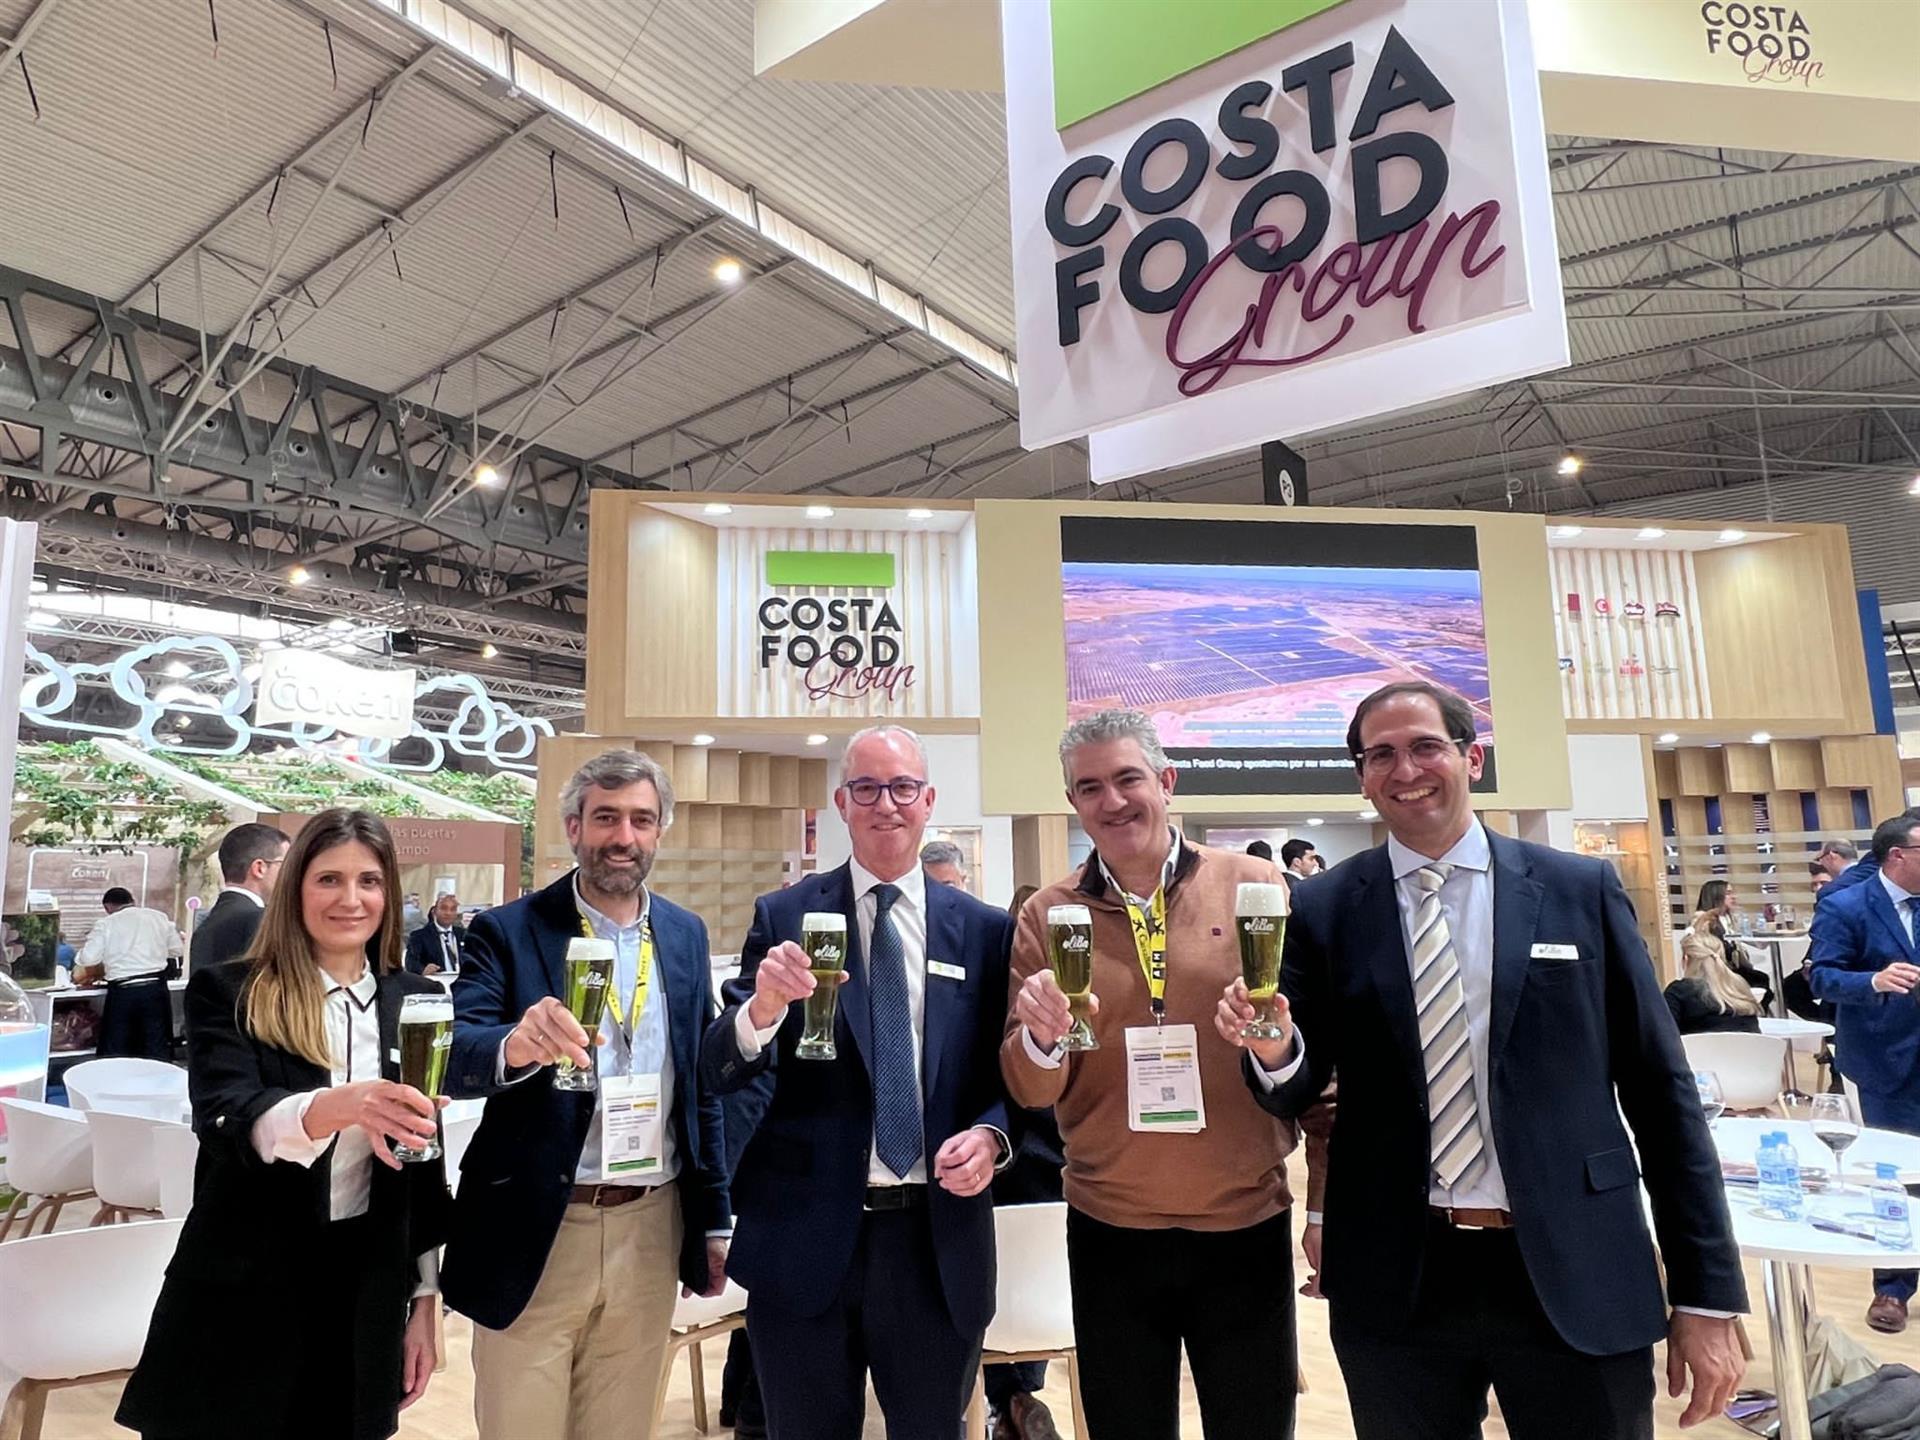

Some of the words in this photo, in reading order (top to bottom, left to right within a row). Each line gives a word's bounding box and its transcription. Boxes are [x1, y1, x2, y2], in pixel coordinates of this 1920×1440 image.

[1701, 1, 1810, 35] COSTA
[1707, 28, 1810, 61] FOOD
[1045, 24, 1455, 247] COSTA
[1055, 131, 1449, 347] FOOD
[758, 597, 902, 632] COSTA
[761, 635, 900, 668] FOOD
[1216, 759, 1243, 770] Group
